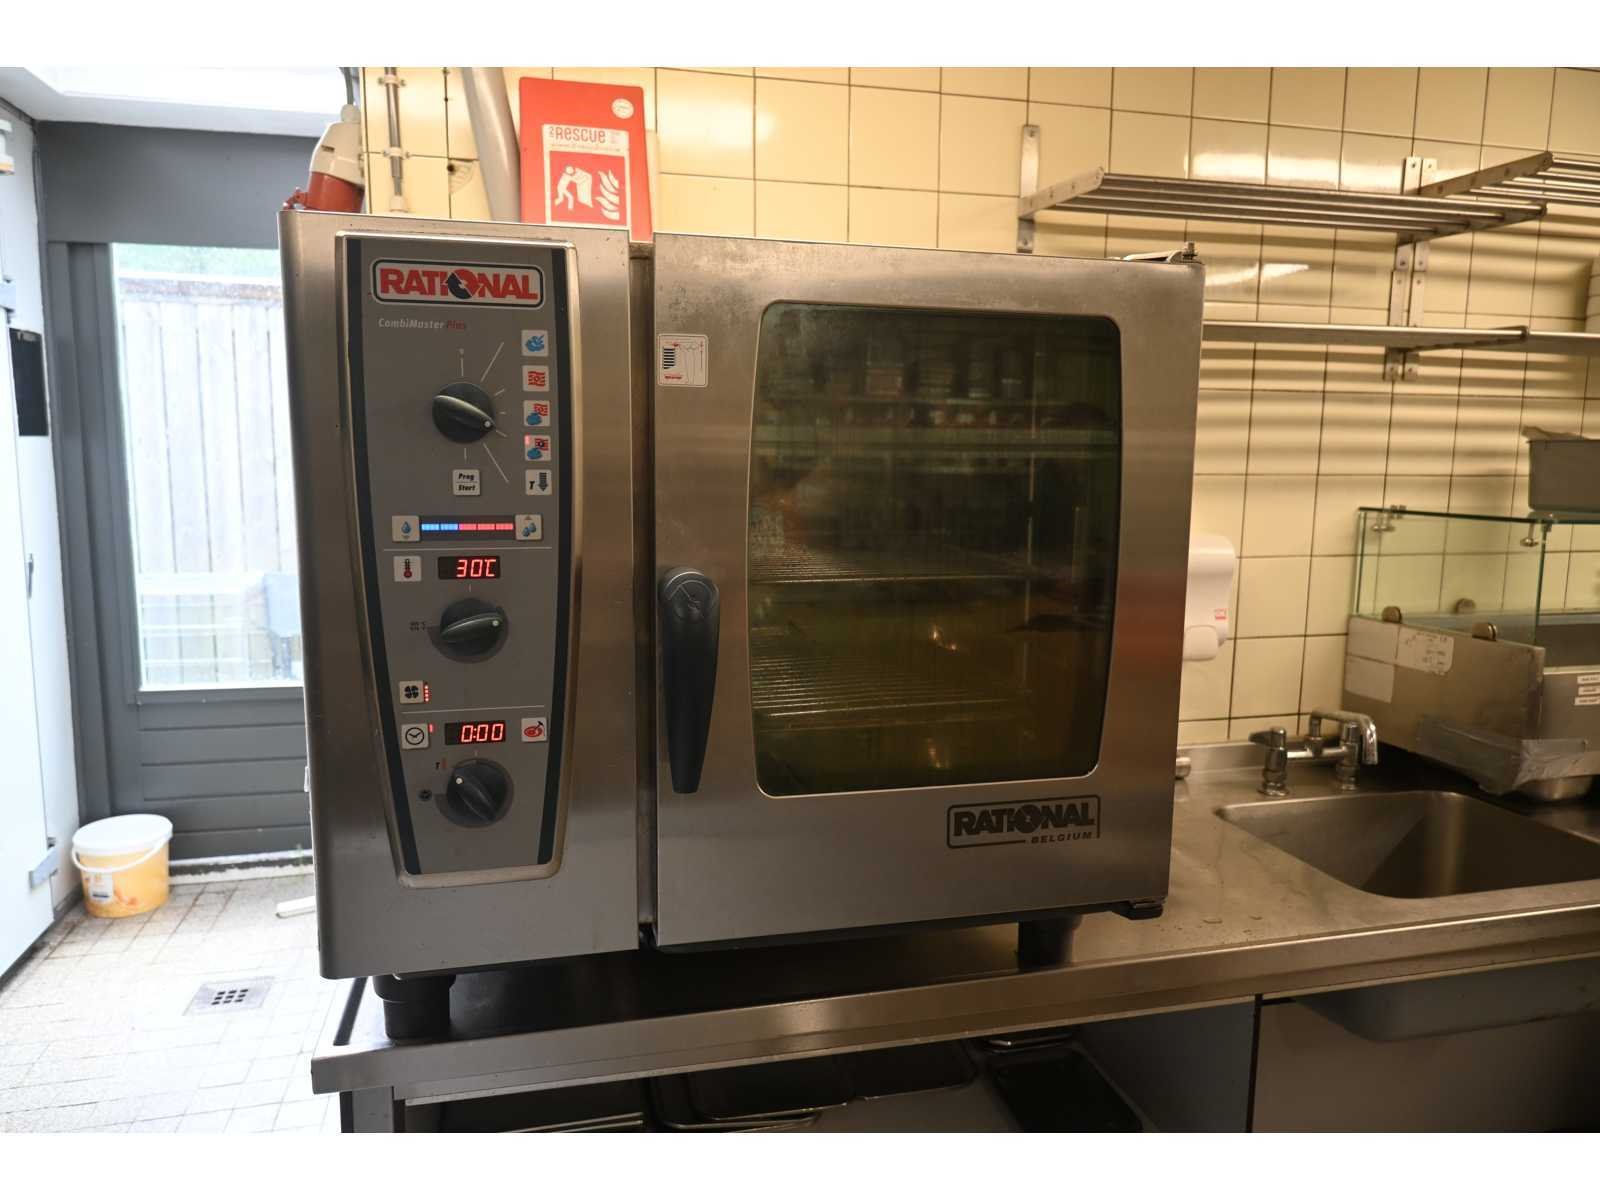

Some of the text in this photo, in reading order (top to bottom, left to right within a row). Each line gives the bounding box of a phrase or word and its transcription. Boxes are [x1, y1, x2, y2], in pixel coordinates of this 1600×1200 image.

[380, 268, 538, 299] RATIONAL
[378, 318, 445, 329] CombiMaster
[458, 472, 475, 481] Prog
[461, 723, 503, 743] 0:00
[953, 803, 1095, 836] RATIONAL
[1031, 832, 1092, 844] BELGIUM
